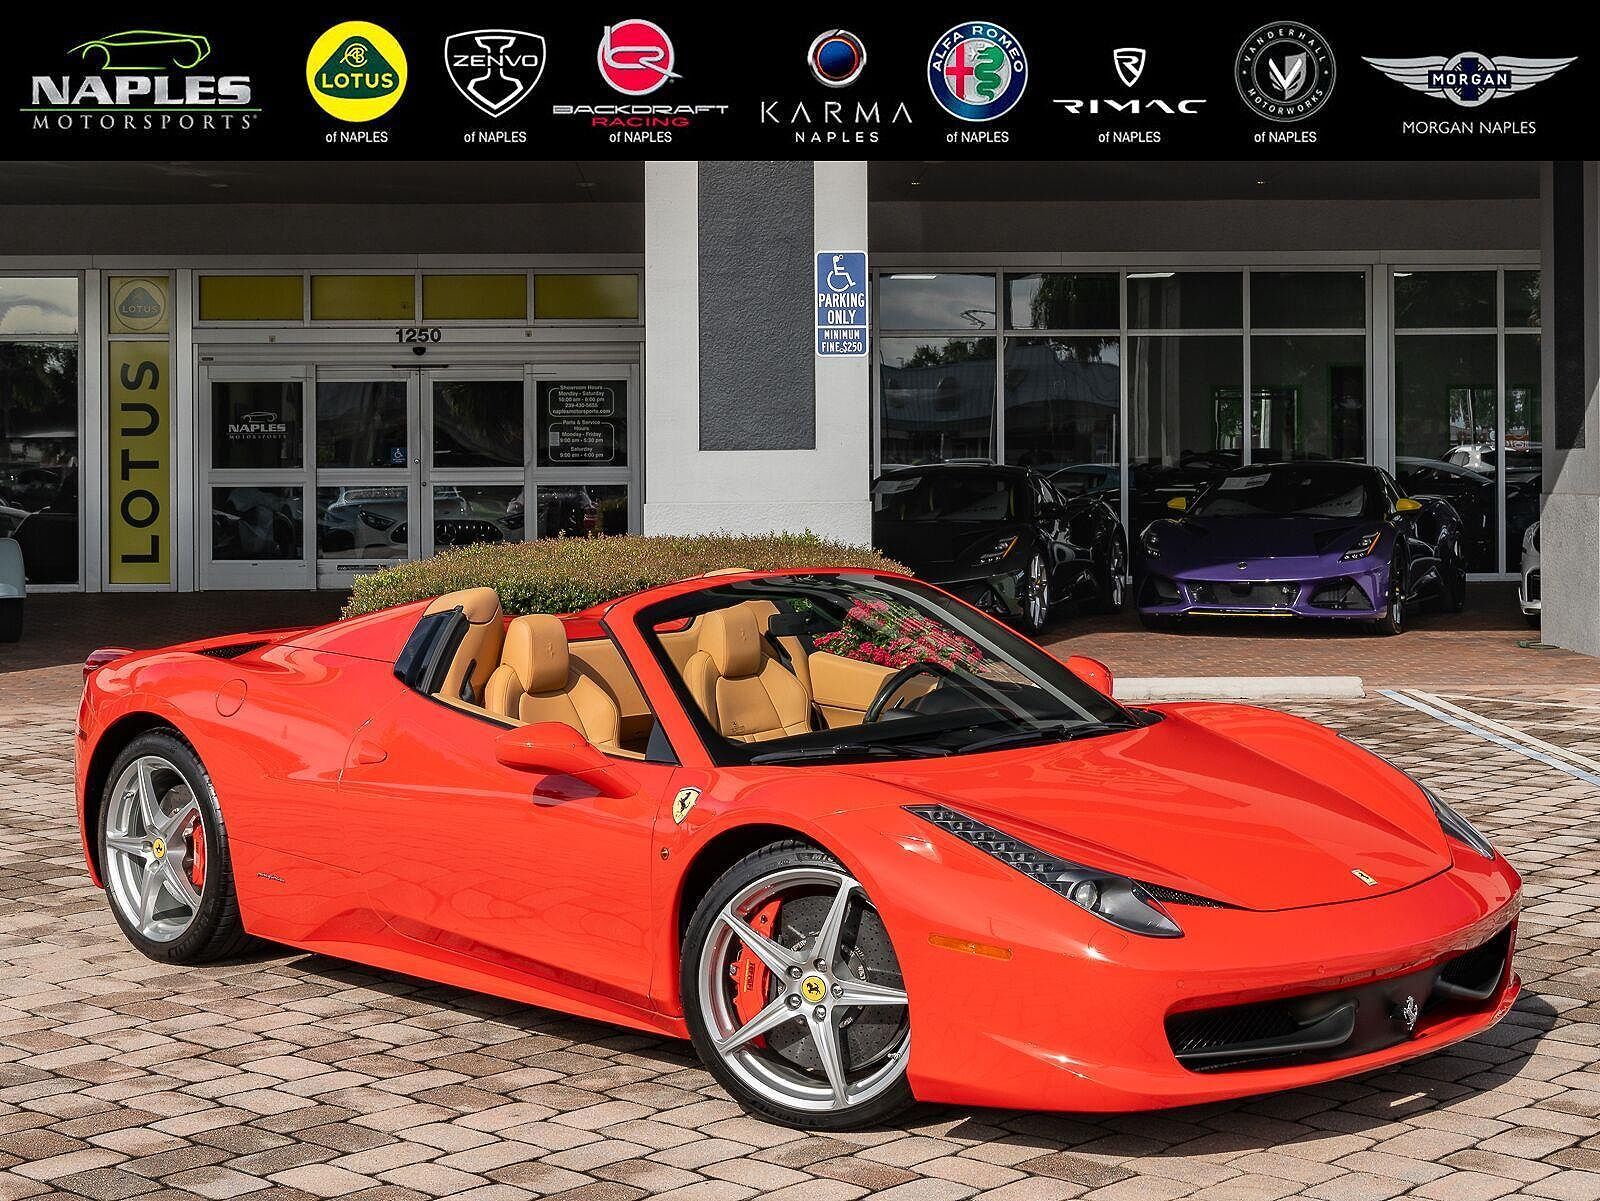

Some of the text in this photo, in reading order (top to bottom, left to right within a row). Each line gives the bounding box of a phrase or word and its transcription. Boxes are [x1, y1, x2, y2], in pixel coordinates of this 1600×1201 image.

[818, 293, 865, 308] PARKING
[122, 305, 160, 313] LOTUS
[827, 309, 856, 325] ONLY
[395, 327, 442, 343] 1250
[824, 329, 860, 340] MINIMUM
[821, 341, 863, 353] FINE $250
[228, 423, 286, 433] NAPLES
[120, 360, 160, 564] LOTUS
